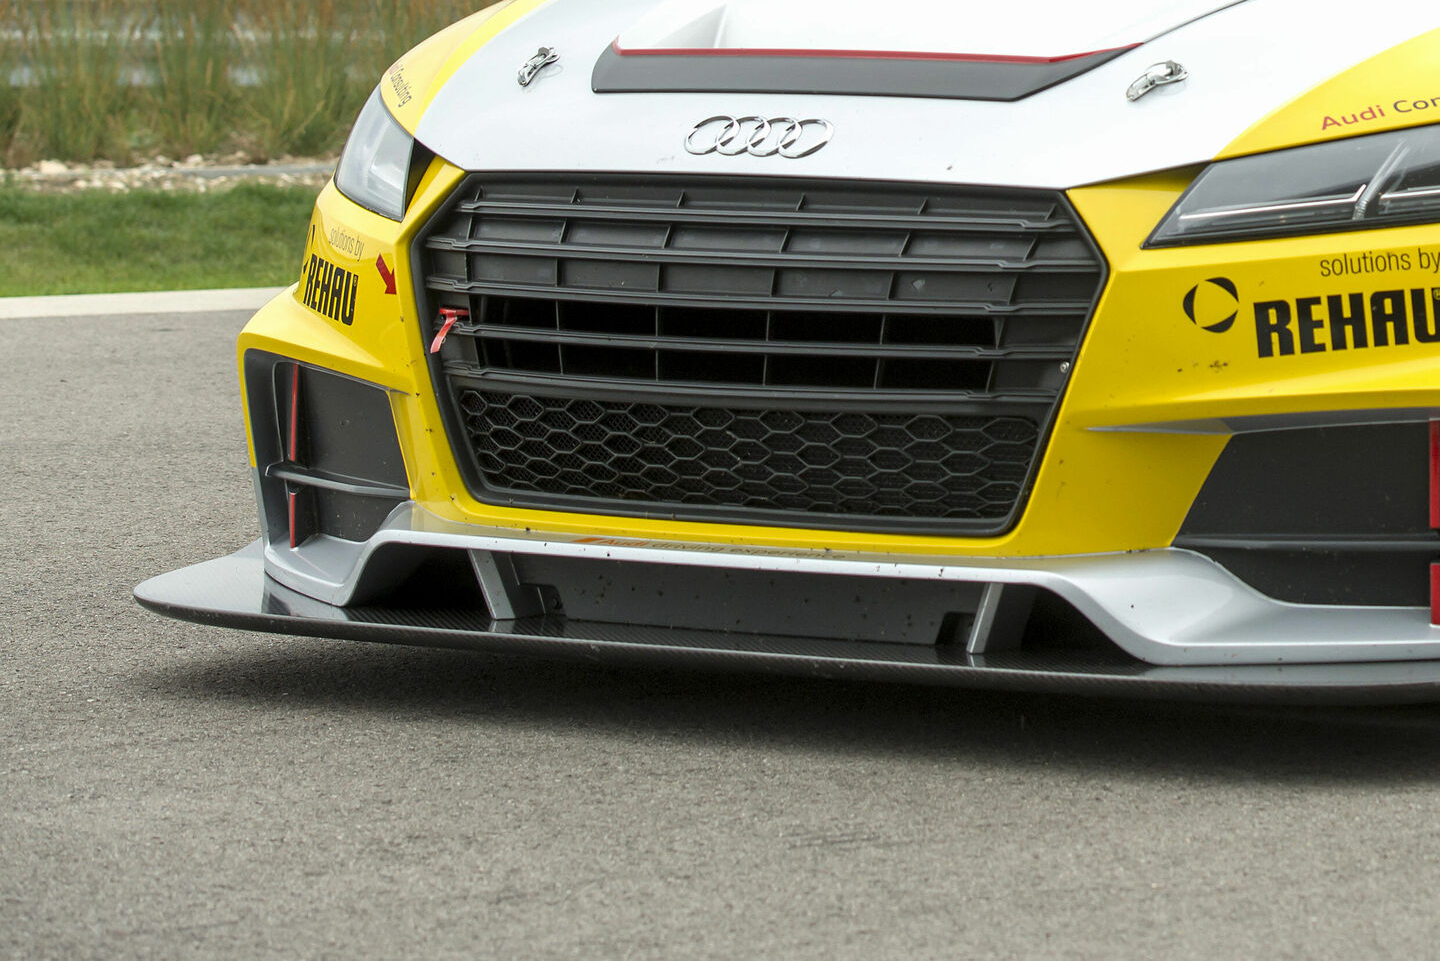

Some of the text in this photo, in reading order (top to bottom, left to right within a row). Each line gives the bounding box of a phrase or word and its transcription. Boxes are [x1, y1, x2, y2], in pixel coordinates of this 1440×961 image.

[1321, 104, 1385, 131] Audi
[1320, 248, 1440, 277] solutions by
